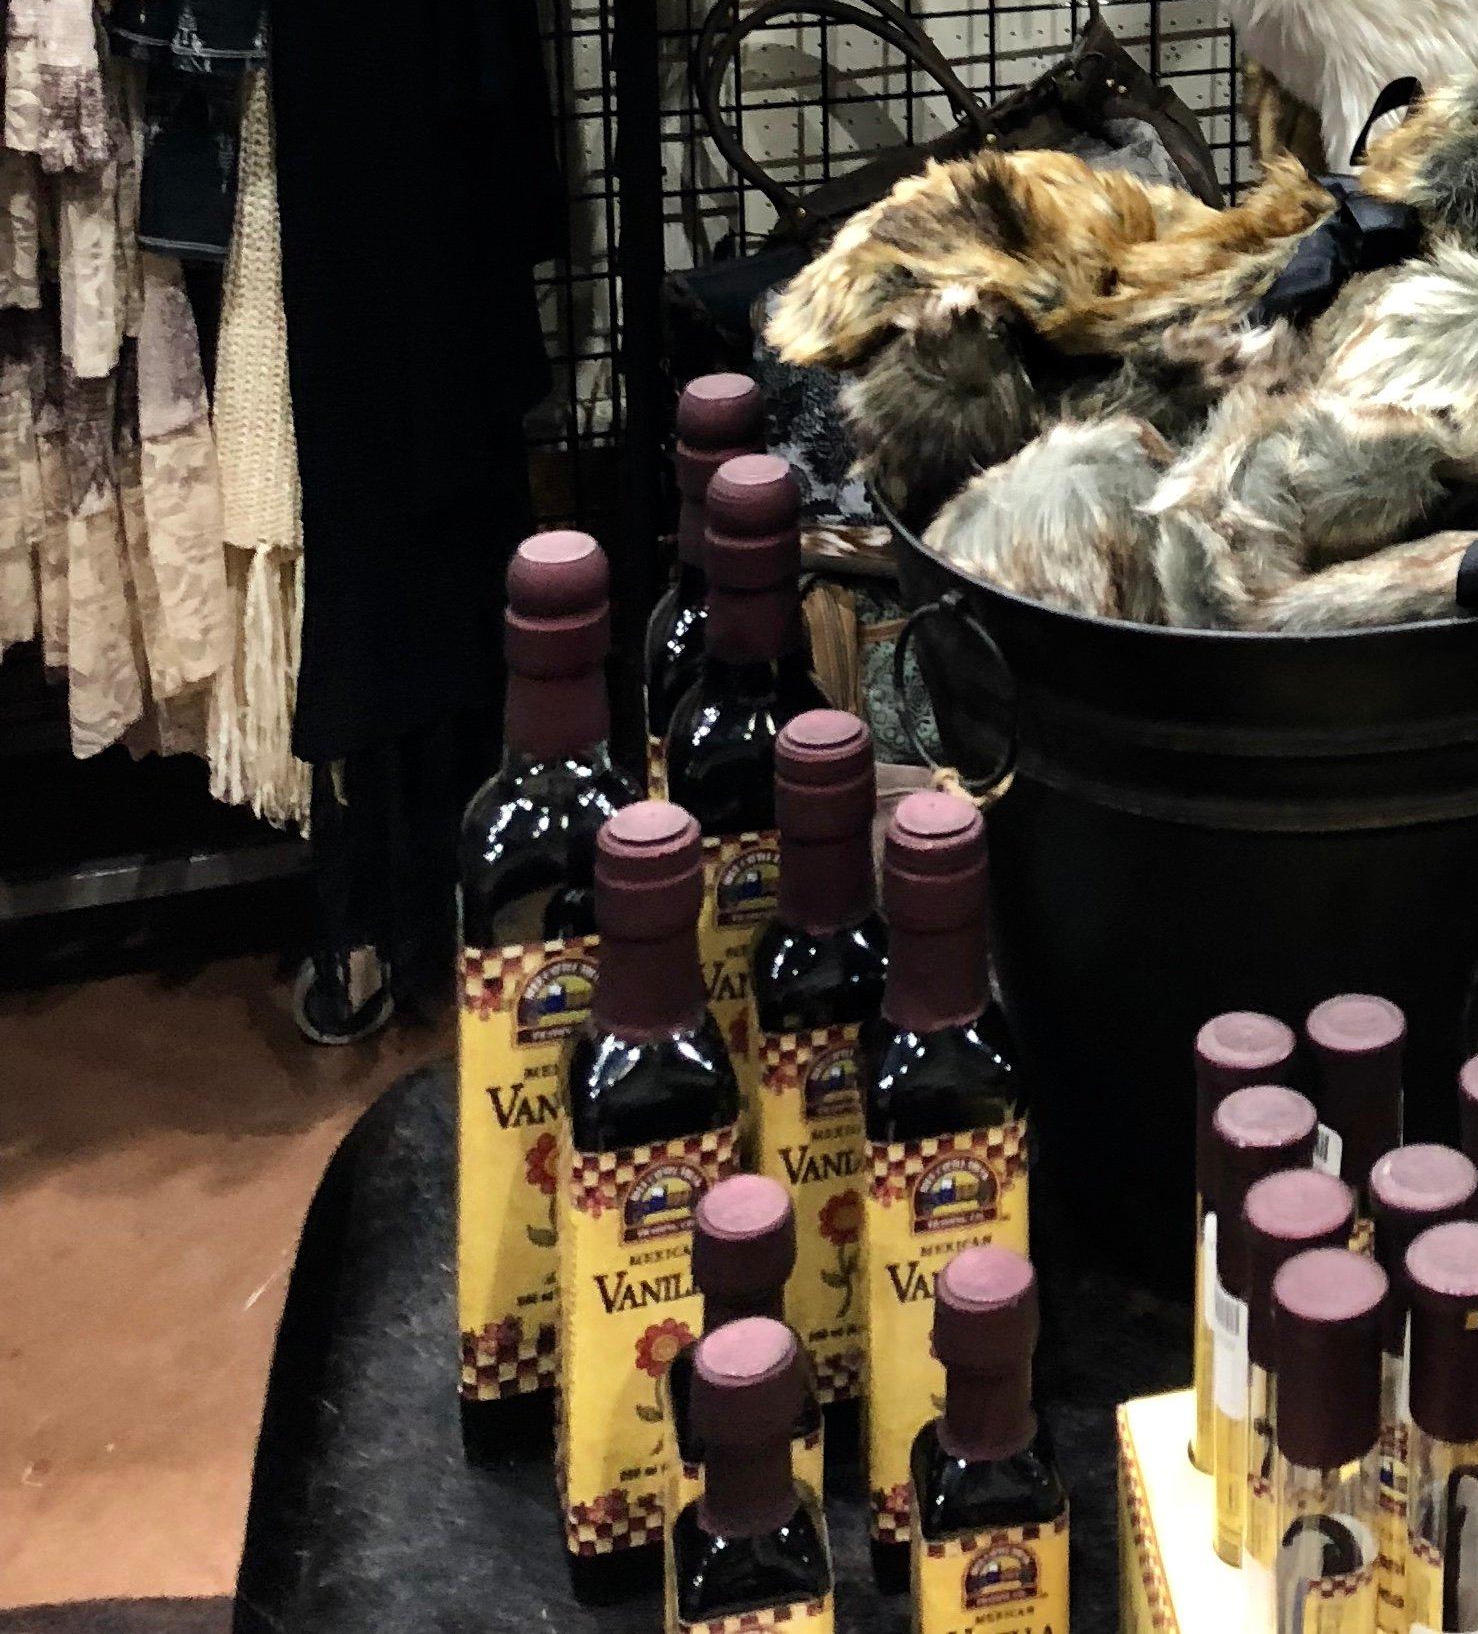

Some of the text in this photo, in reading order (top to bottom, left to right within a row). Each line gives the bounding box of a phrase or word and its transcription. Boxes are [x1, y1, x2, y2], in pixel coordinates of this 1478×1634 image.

[486, 1082, 560, 1129] VAN
[629, 1245, 691, 1266] MEXICA
[593, 1270, 697, 1313] VANIL
[886, 1260, 936, 1303] VA
